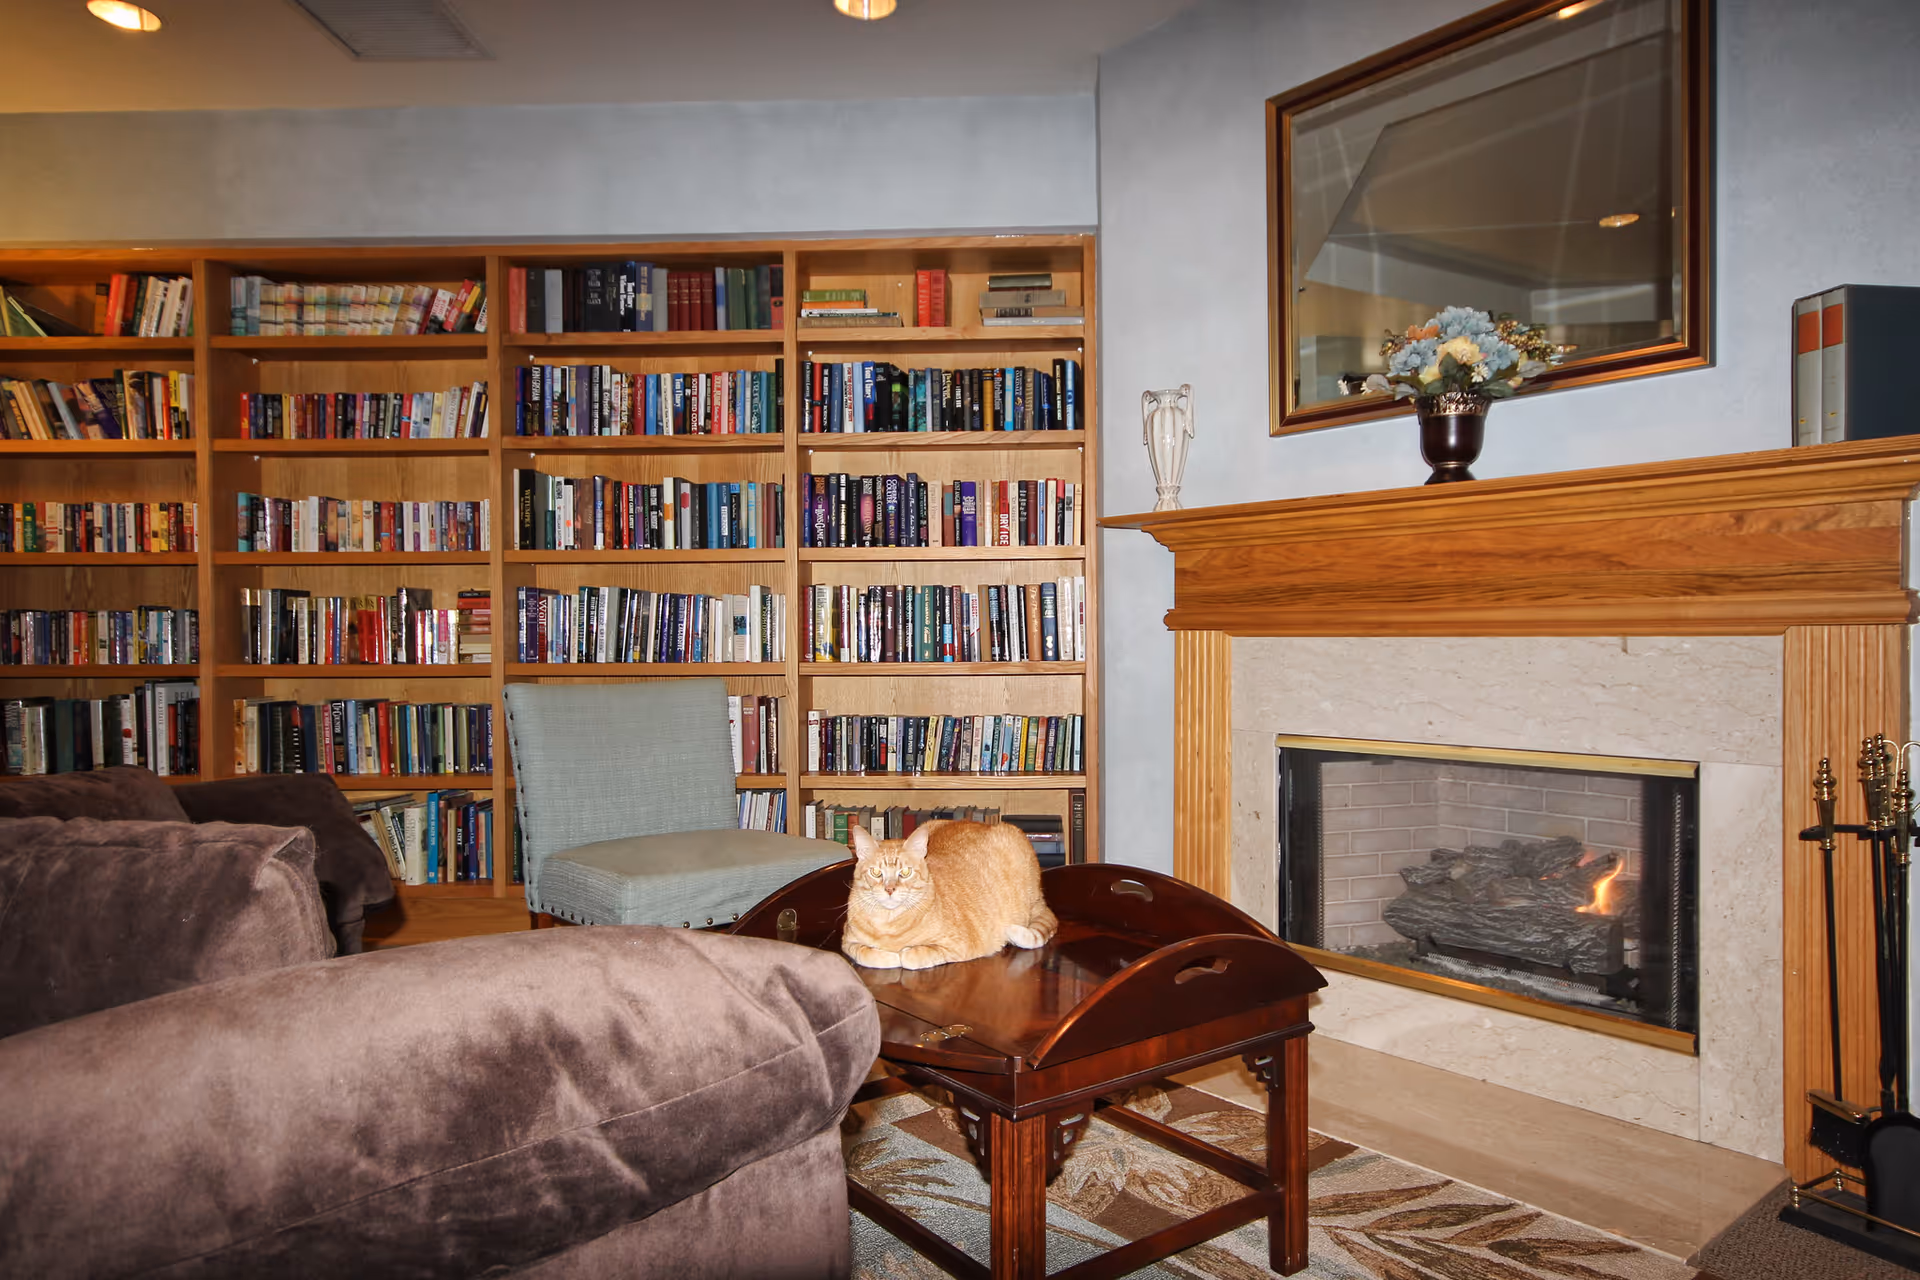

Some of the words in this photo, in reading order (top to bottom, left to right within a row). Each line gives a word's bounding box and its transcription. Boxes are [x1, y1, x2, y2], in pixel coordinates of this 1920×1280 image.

[865, 366, 873, 379] Tom
[994, 378, 1002, 410] Retribution
[1000, 514, 1009, 529] DRY
[1000, 531, 1009, 545] ICE
